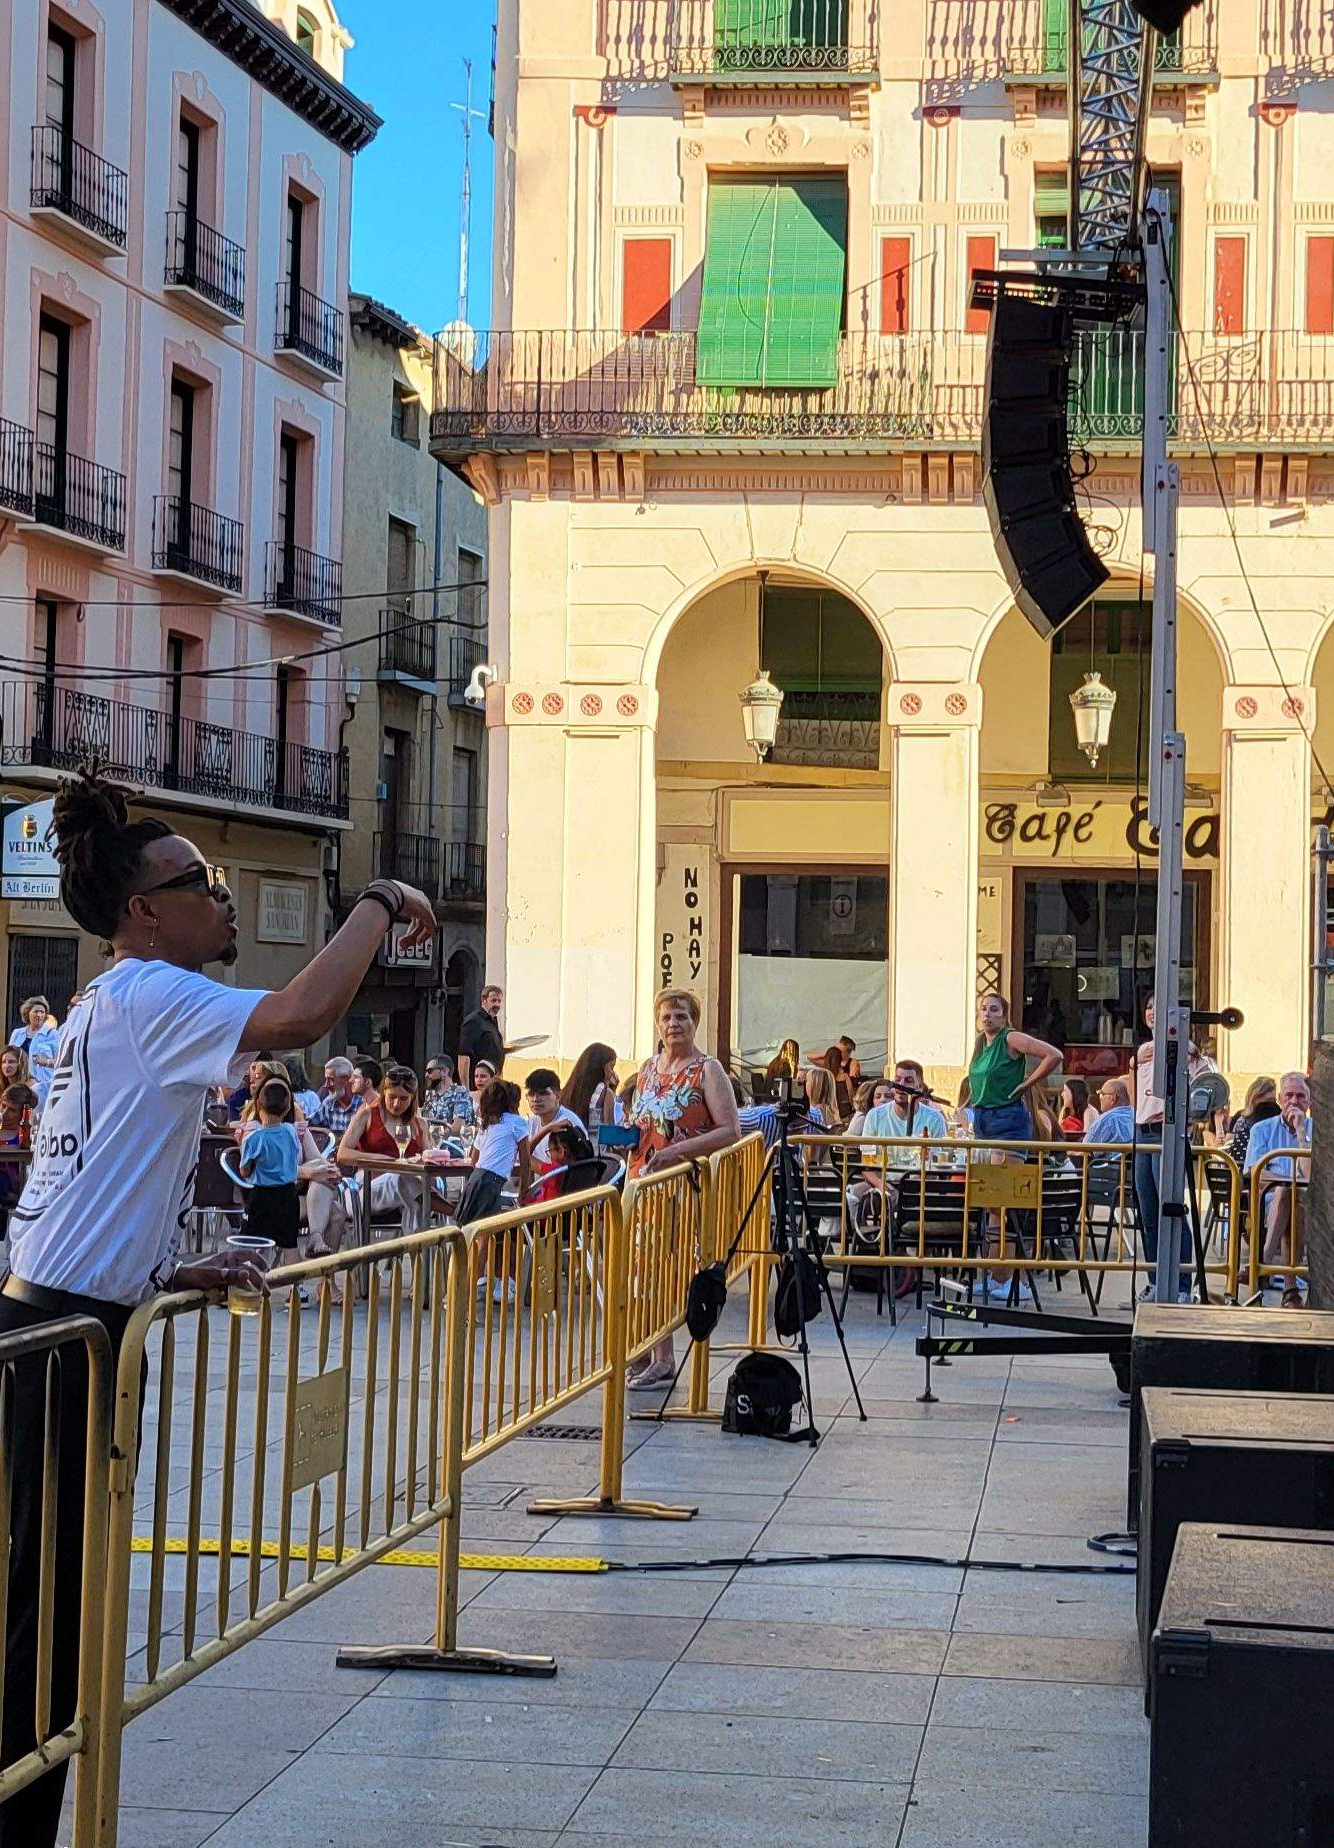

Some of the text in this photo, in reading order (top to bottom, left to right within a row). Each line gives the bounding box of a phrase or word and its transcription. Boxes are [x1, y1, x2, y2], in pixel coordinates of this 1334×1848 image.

[8, 841, 53, 853] VELTINS
[985, 799, 1103, 858] Café
[684, 866, 698, 909] NO
[688, 915, 702, 980] HAY
